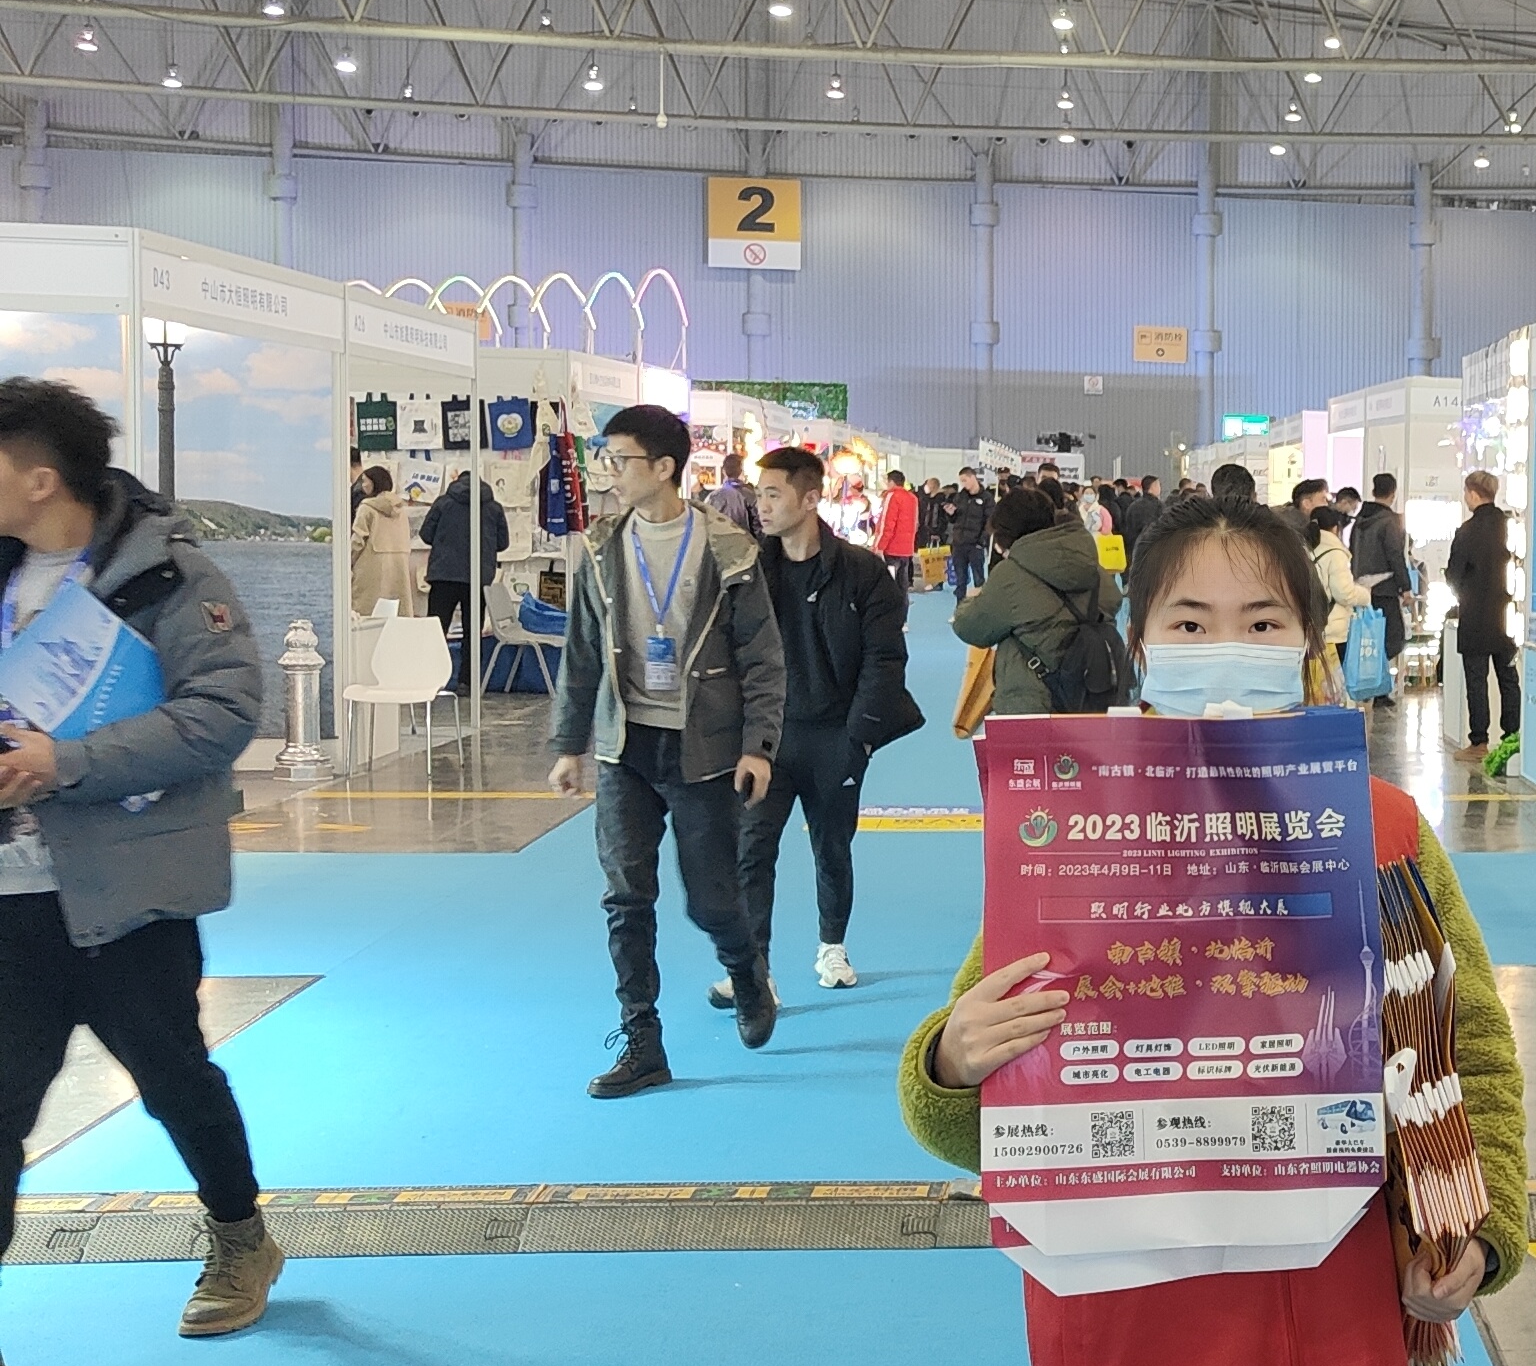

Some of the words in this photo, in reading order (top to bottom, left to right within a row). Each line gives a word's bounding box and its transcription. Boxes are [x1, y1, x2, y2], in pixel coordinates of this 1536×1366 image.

[736, 186, 776, 233] 2
[153, 267, 170, 290] D43
[201, 277, 288, 317] 中山市大恒照明有限公司
[1433, 395, 1461, 409] A14
[1067, 807, 1347, 843] 2023临沂照明展览会
[1210, 847, 1258, 857] EXHIBITION
[1072, 1045, 1108, 1055] 户外照明
[1135, 1044, 1172, 1053] 灯具灯饰
[1199, 1042, 1235, 1051] LED照明
[1260, 1039, 1293, 1049] 家居照明
[1072, 1069, 1108, 1080] 城市亮化
[1134, 1067, 1171, 1076] 电工电器
[1198, 1065, 1233, 1075] 标识标牌
[1254, 1062, 1296, 1073] 光伏新能源
[993, 1143, 1084, 1158] 15092900726
[1155, 1134, 1246, 1150] 0539-8899979
